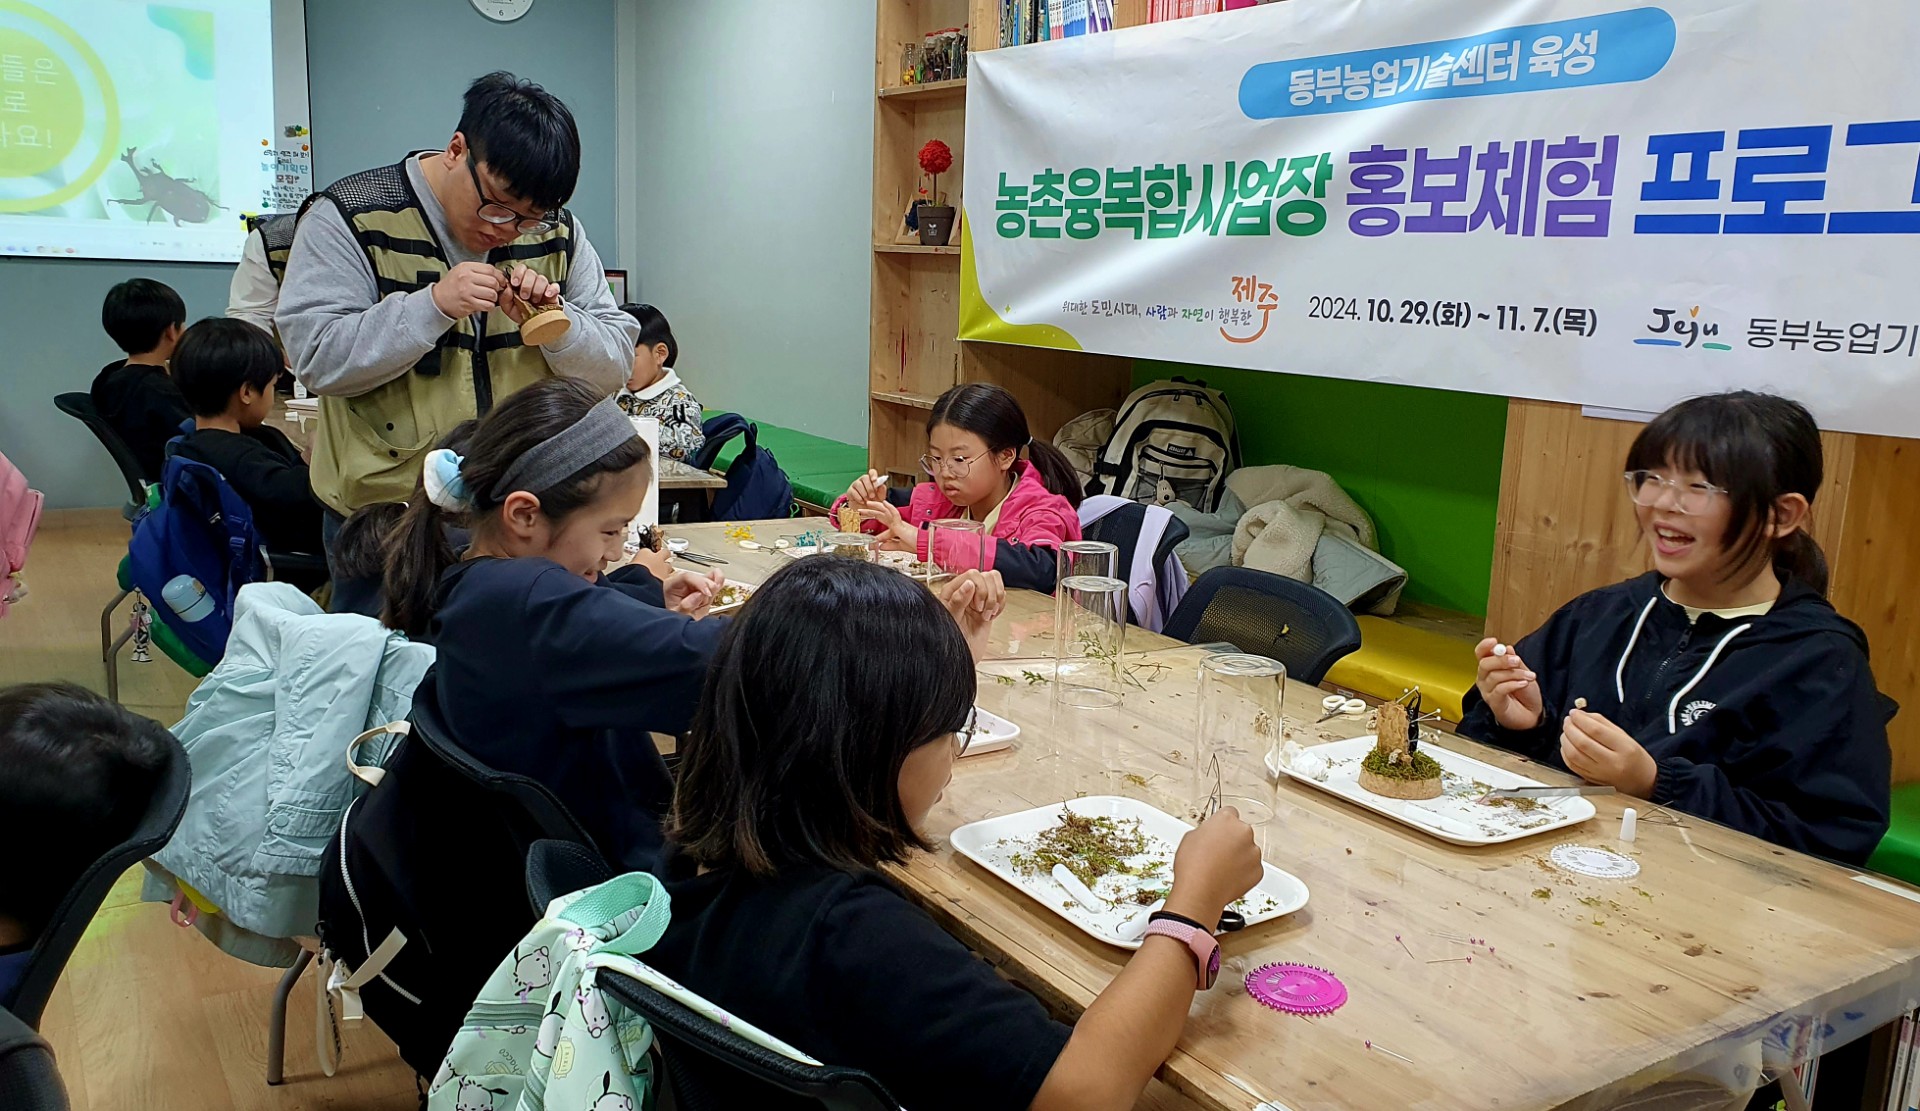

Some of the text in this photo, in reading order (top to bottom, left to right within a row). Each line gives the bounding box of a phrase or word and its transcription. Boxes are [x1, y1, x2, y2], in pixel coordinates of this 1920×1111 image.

[1288, 30, 1599, 106] 동부농업기술센터 육성
[995, 152, 1334, 240] 농촌융복합사업장
[1345, 135, 1620, 238] 홍보체험
[1062, 275, 1279, 332] 위대한 도민시대, 사람과 자연이 행복한 제주
[1308, 295, 1361, 321] 2024.
[1367, 298, 1394, 323] 10.
[1400, 300, 1472, 328] 29.(화)
[1497, 305, 1526, 332] 11.
[1533, 306, 1597, 337] 7.(목)
[1646, 306, 1719, 348] Jeju
[1747, 318, 1920, 357] 동부농업기
